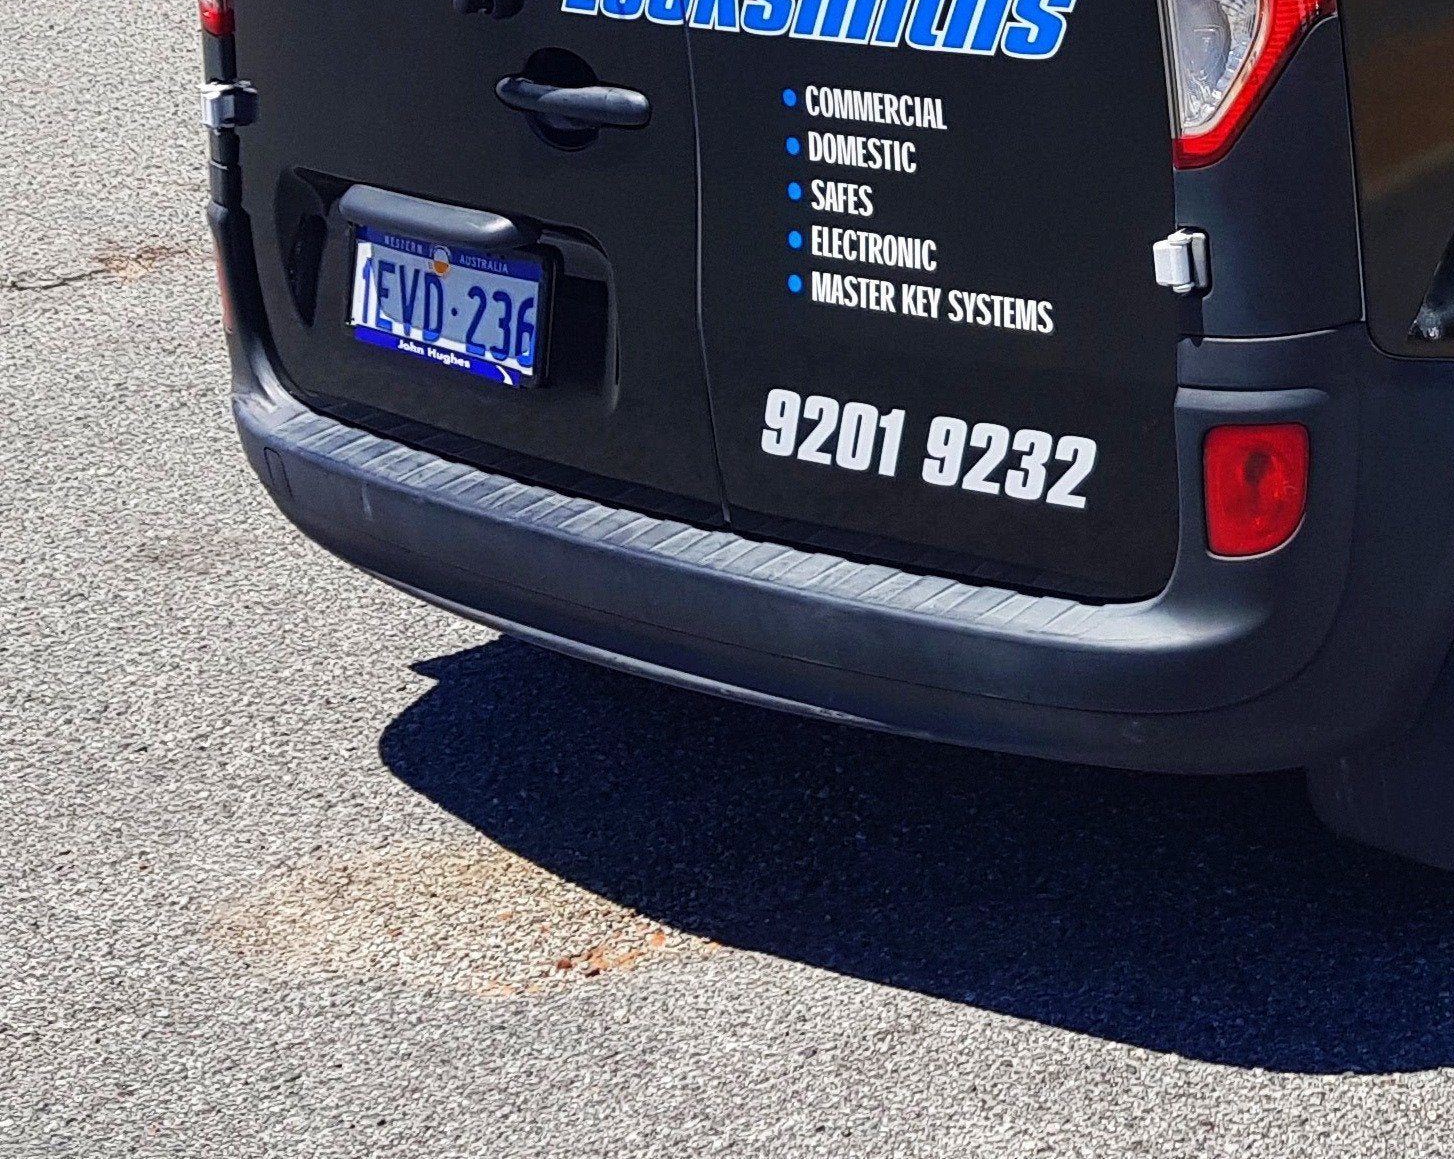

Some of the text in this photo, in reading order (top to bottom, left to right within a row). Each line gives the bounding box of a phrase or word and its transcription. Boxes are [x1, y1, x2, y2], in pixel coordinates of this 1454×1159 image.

[805, 85, 948, 130] COMMERCIAL
[807, 131, 917, 173] DOMESTIC
[811, 179, 874, 217] SAFES
[460, 254, 509, 274] AUSTRALIA
[811, 224, 937, 271] ELECTRONIC
[811, 271, 1054, 334] MASTER KEY SYSTEMS
[398, 340, 471, 369] John Hughes
[761, 388, 1097, 509] 9201 9232
